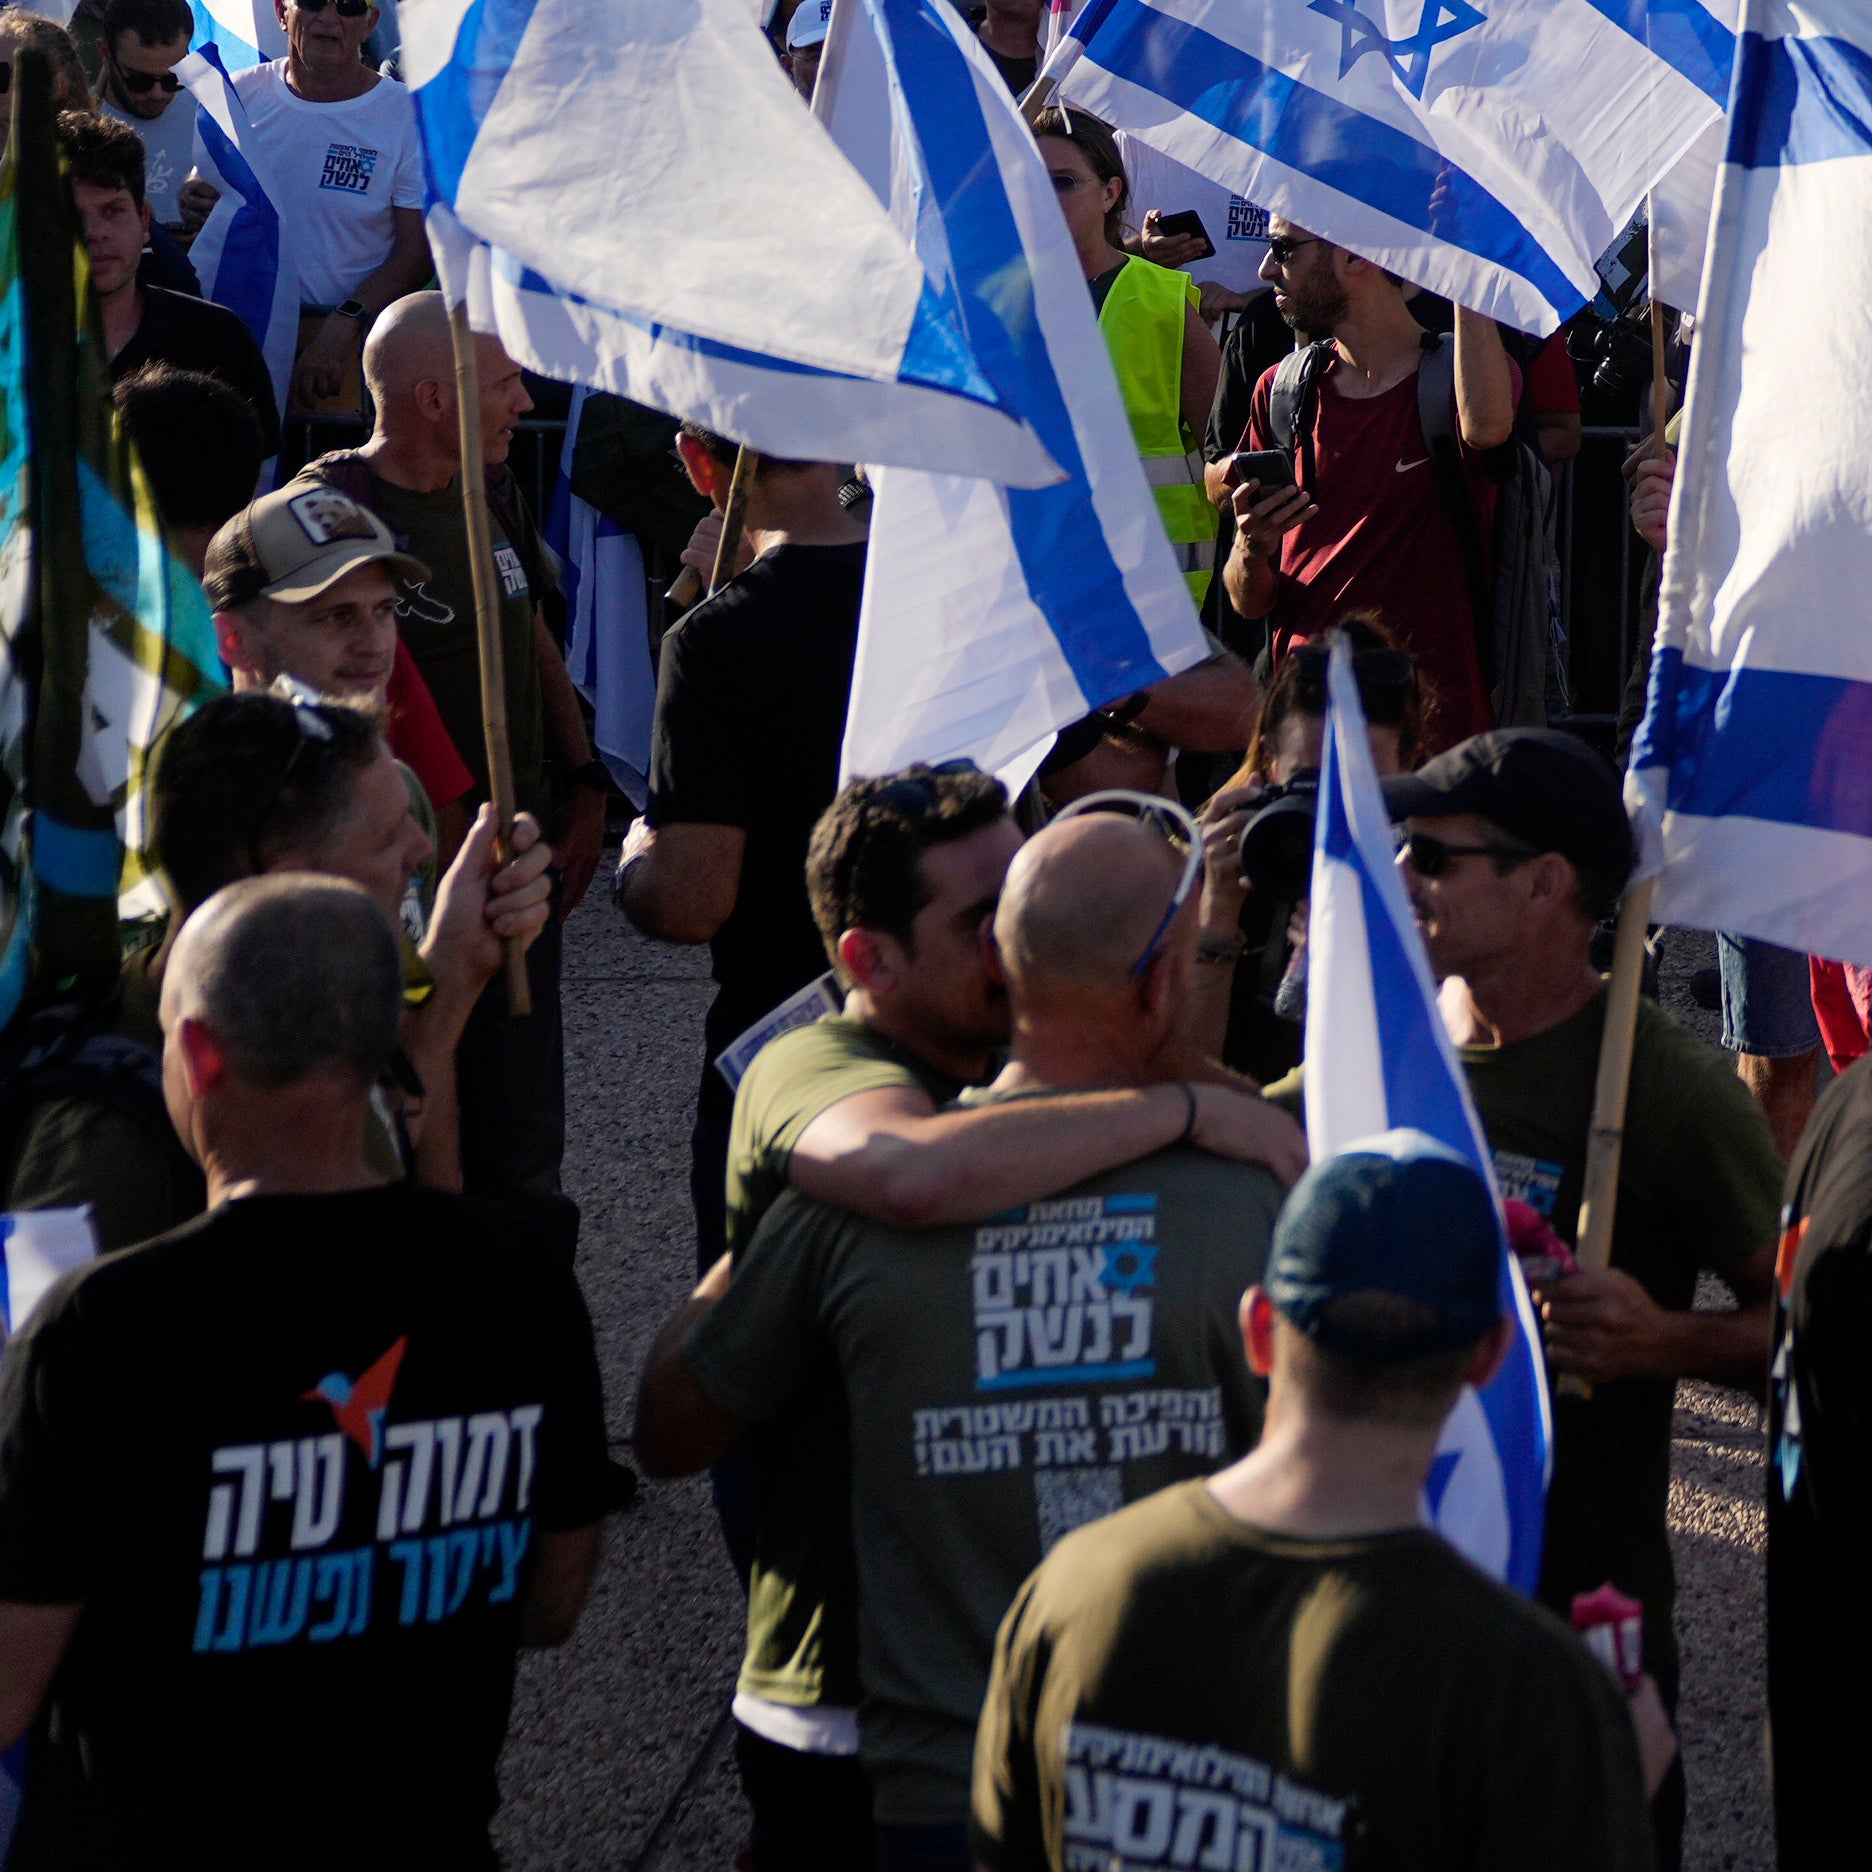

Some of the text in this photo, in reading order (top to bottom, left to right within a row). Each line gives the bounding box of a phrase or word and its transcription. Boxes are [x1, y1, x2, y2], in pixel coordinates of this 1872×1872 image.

[319, 169, 371, 191] לנשק
[324, 154, 362, 174] אחים
[1228, 205, 1264, 223] אחים
[970, 1240, 1107, 1309] אחים
[973, 1285, 1153, 1379] לנשק
[1035, 1426, 1098, 1463] את
[192, 1516, 531, 1654] ציפור נפשנו
